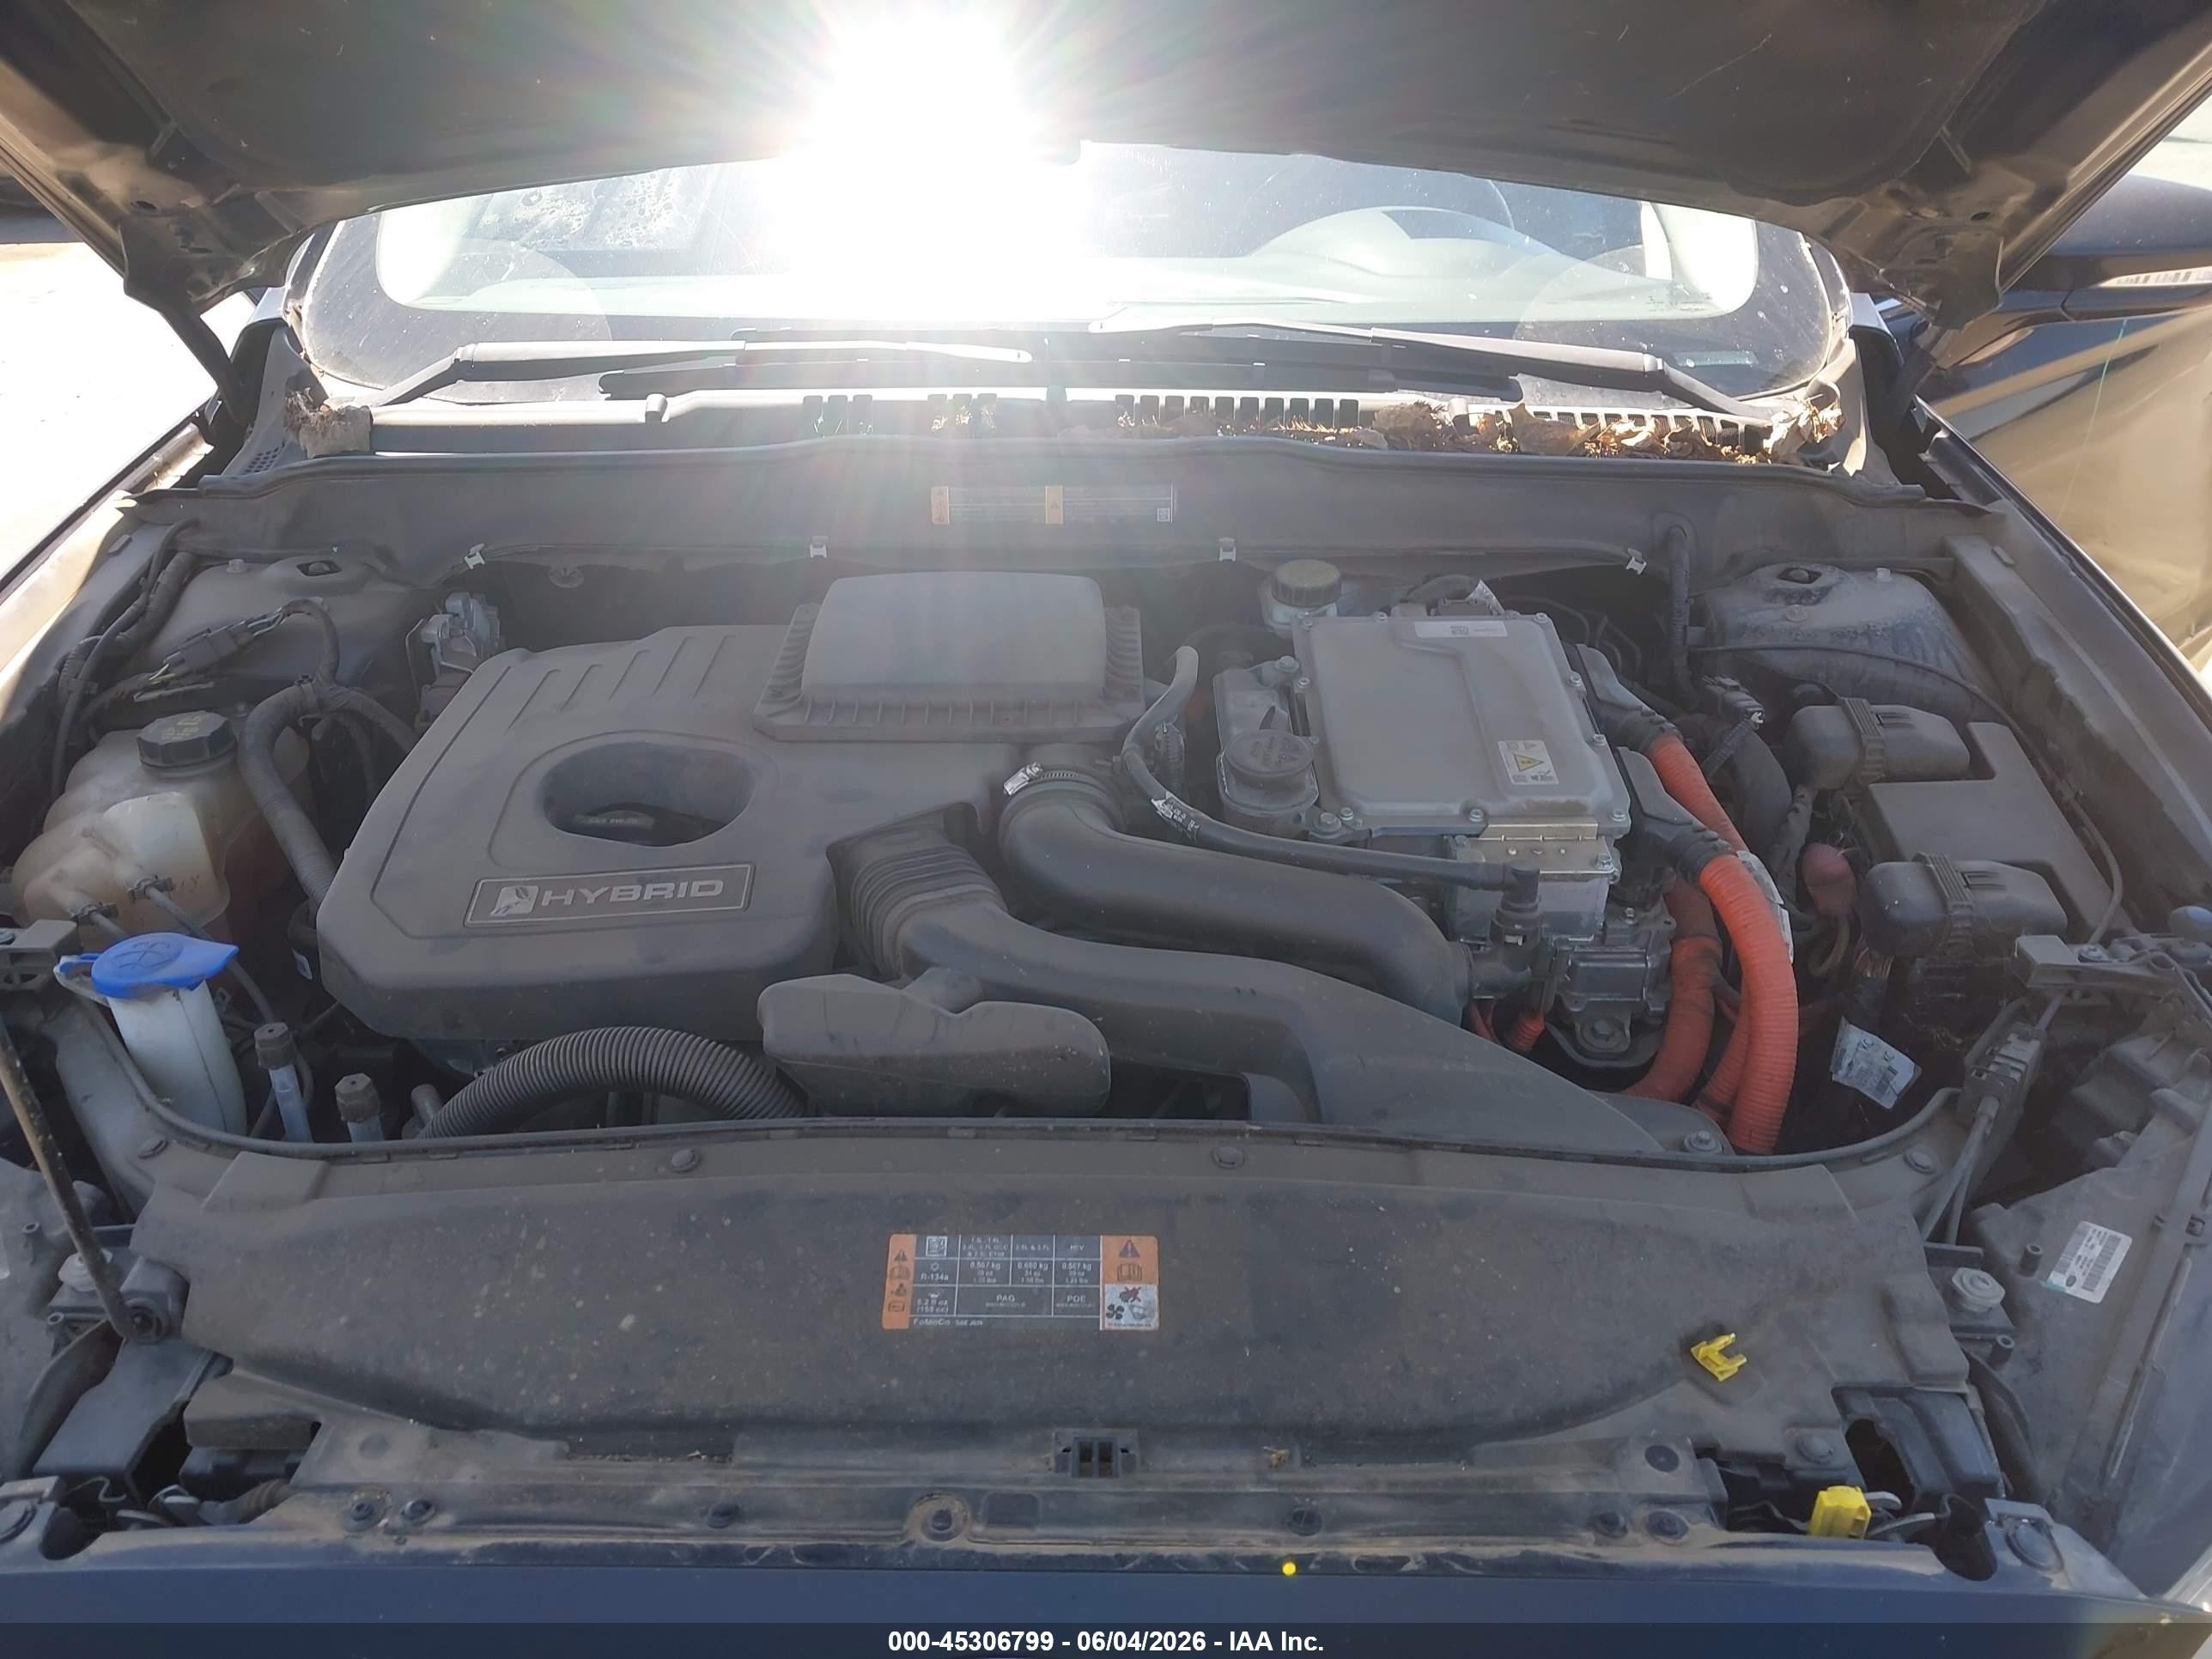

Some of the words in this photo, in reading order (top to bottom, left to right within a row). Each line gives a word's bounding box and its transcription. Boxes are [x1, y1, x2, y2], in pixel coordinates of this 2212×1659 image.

[541, 879, 724, 907] HYBRID
[991, 1261, 1001, 1271] kg
[1039, 1261, 1048, 1272] kg
[1082, 1261, 1092, 1272] kg
[920, 1272, 949, 1281] R-134a
[1066, 1294, 1086, 1303] POE
[913, 1317, 951, 1327] FoMoCo
